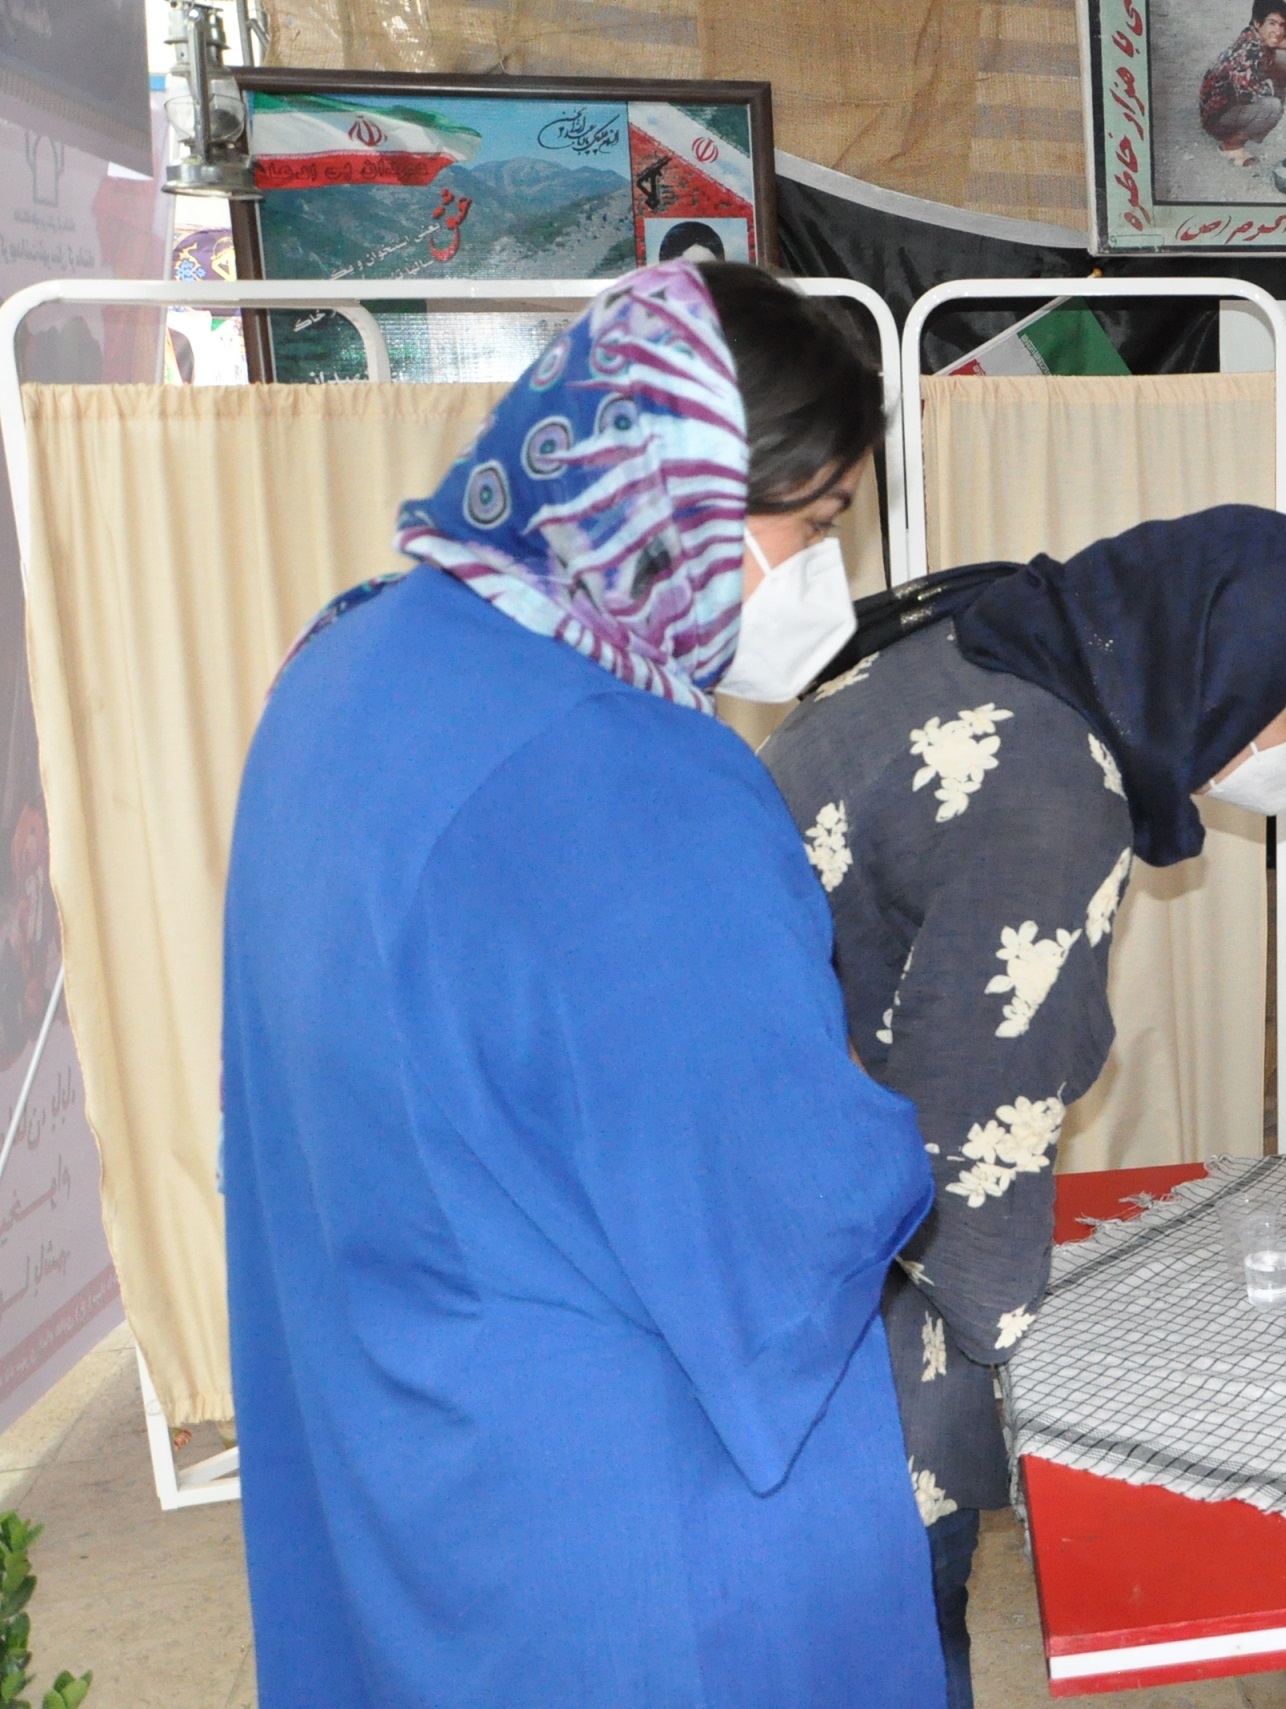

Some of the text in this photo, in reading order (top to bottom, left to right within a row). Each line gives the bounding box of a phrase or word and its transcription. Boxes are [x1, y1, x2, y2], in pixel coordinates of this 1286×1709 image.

[414, 222, 442, 244] یعنی
[1175, 214, 1232, 241] (ص)
[365, 235, 411, 268] استخوان
